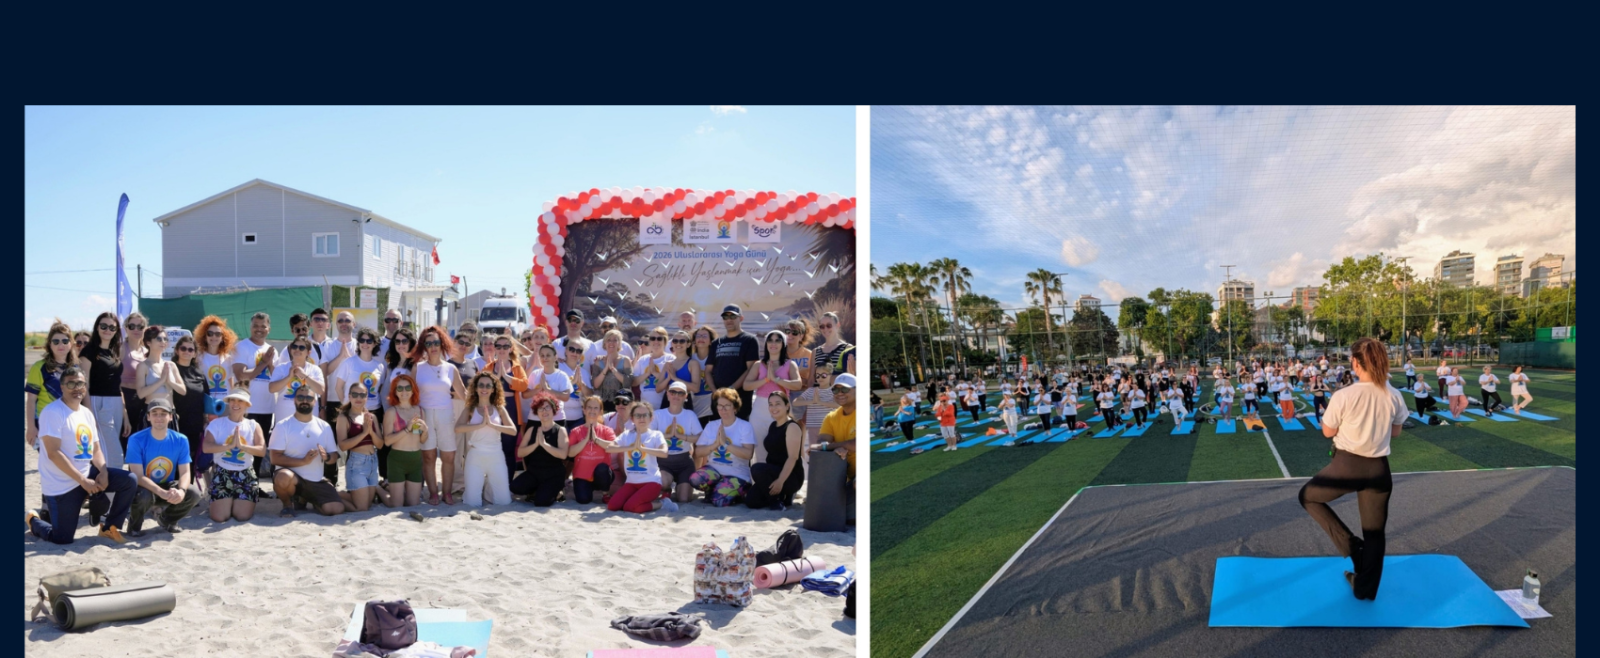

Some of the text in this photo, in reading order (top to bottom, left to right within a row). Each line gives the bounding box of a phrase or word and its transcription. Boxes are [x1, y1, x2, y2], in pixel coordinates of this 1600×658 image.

[653, 250, 767, 260] 2026 Uluslararası Yoga Günü
[791, 357, 809, 368] VE
